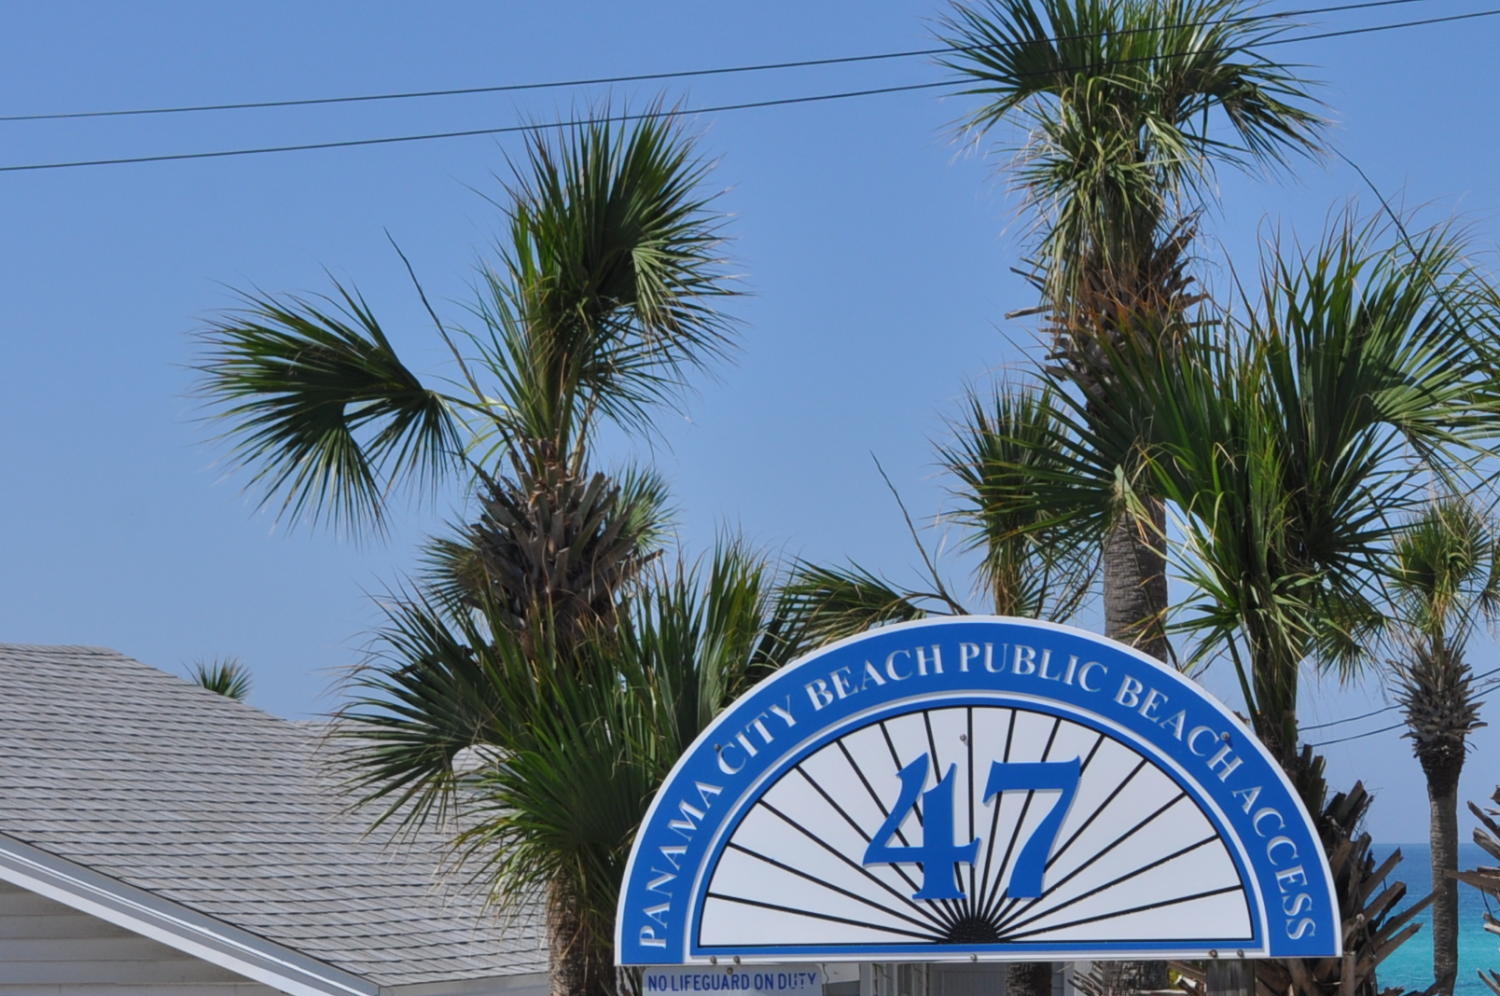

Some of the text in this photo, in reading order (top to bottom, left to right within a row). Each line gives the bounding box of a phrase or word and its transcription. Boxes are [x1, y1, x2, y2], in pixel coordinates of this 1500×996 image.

[640, 641, 1317, 949] PANAMA CITY BEACH PUBLIC BEACH ACCESS
[863, 751, 1082, 900] 47
[648, 972, 817, 992] NO LIFEGUARD ON DUTY
